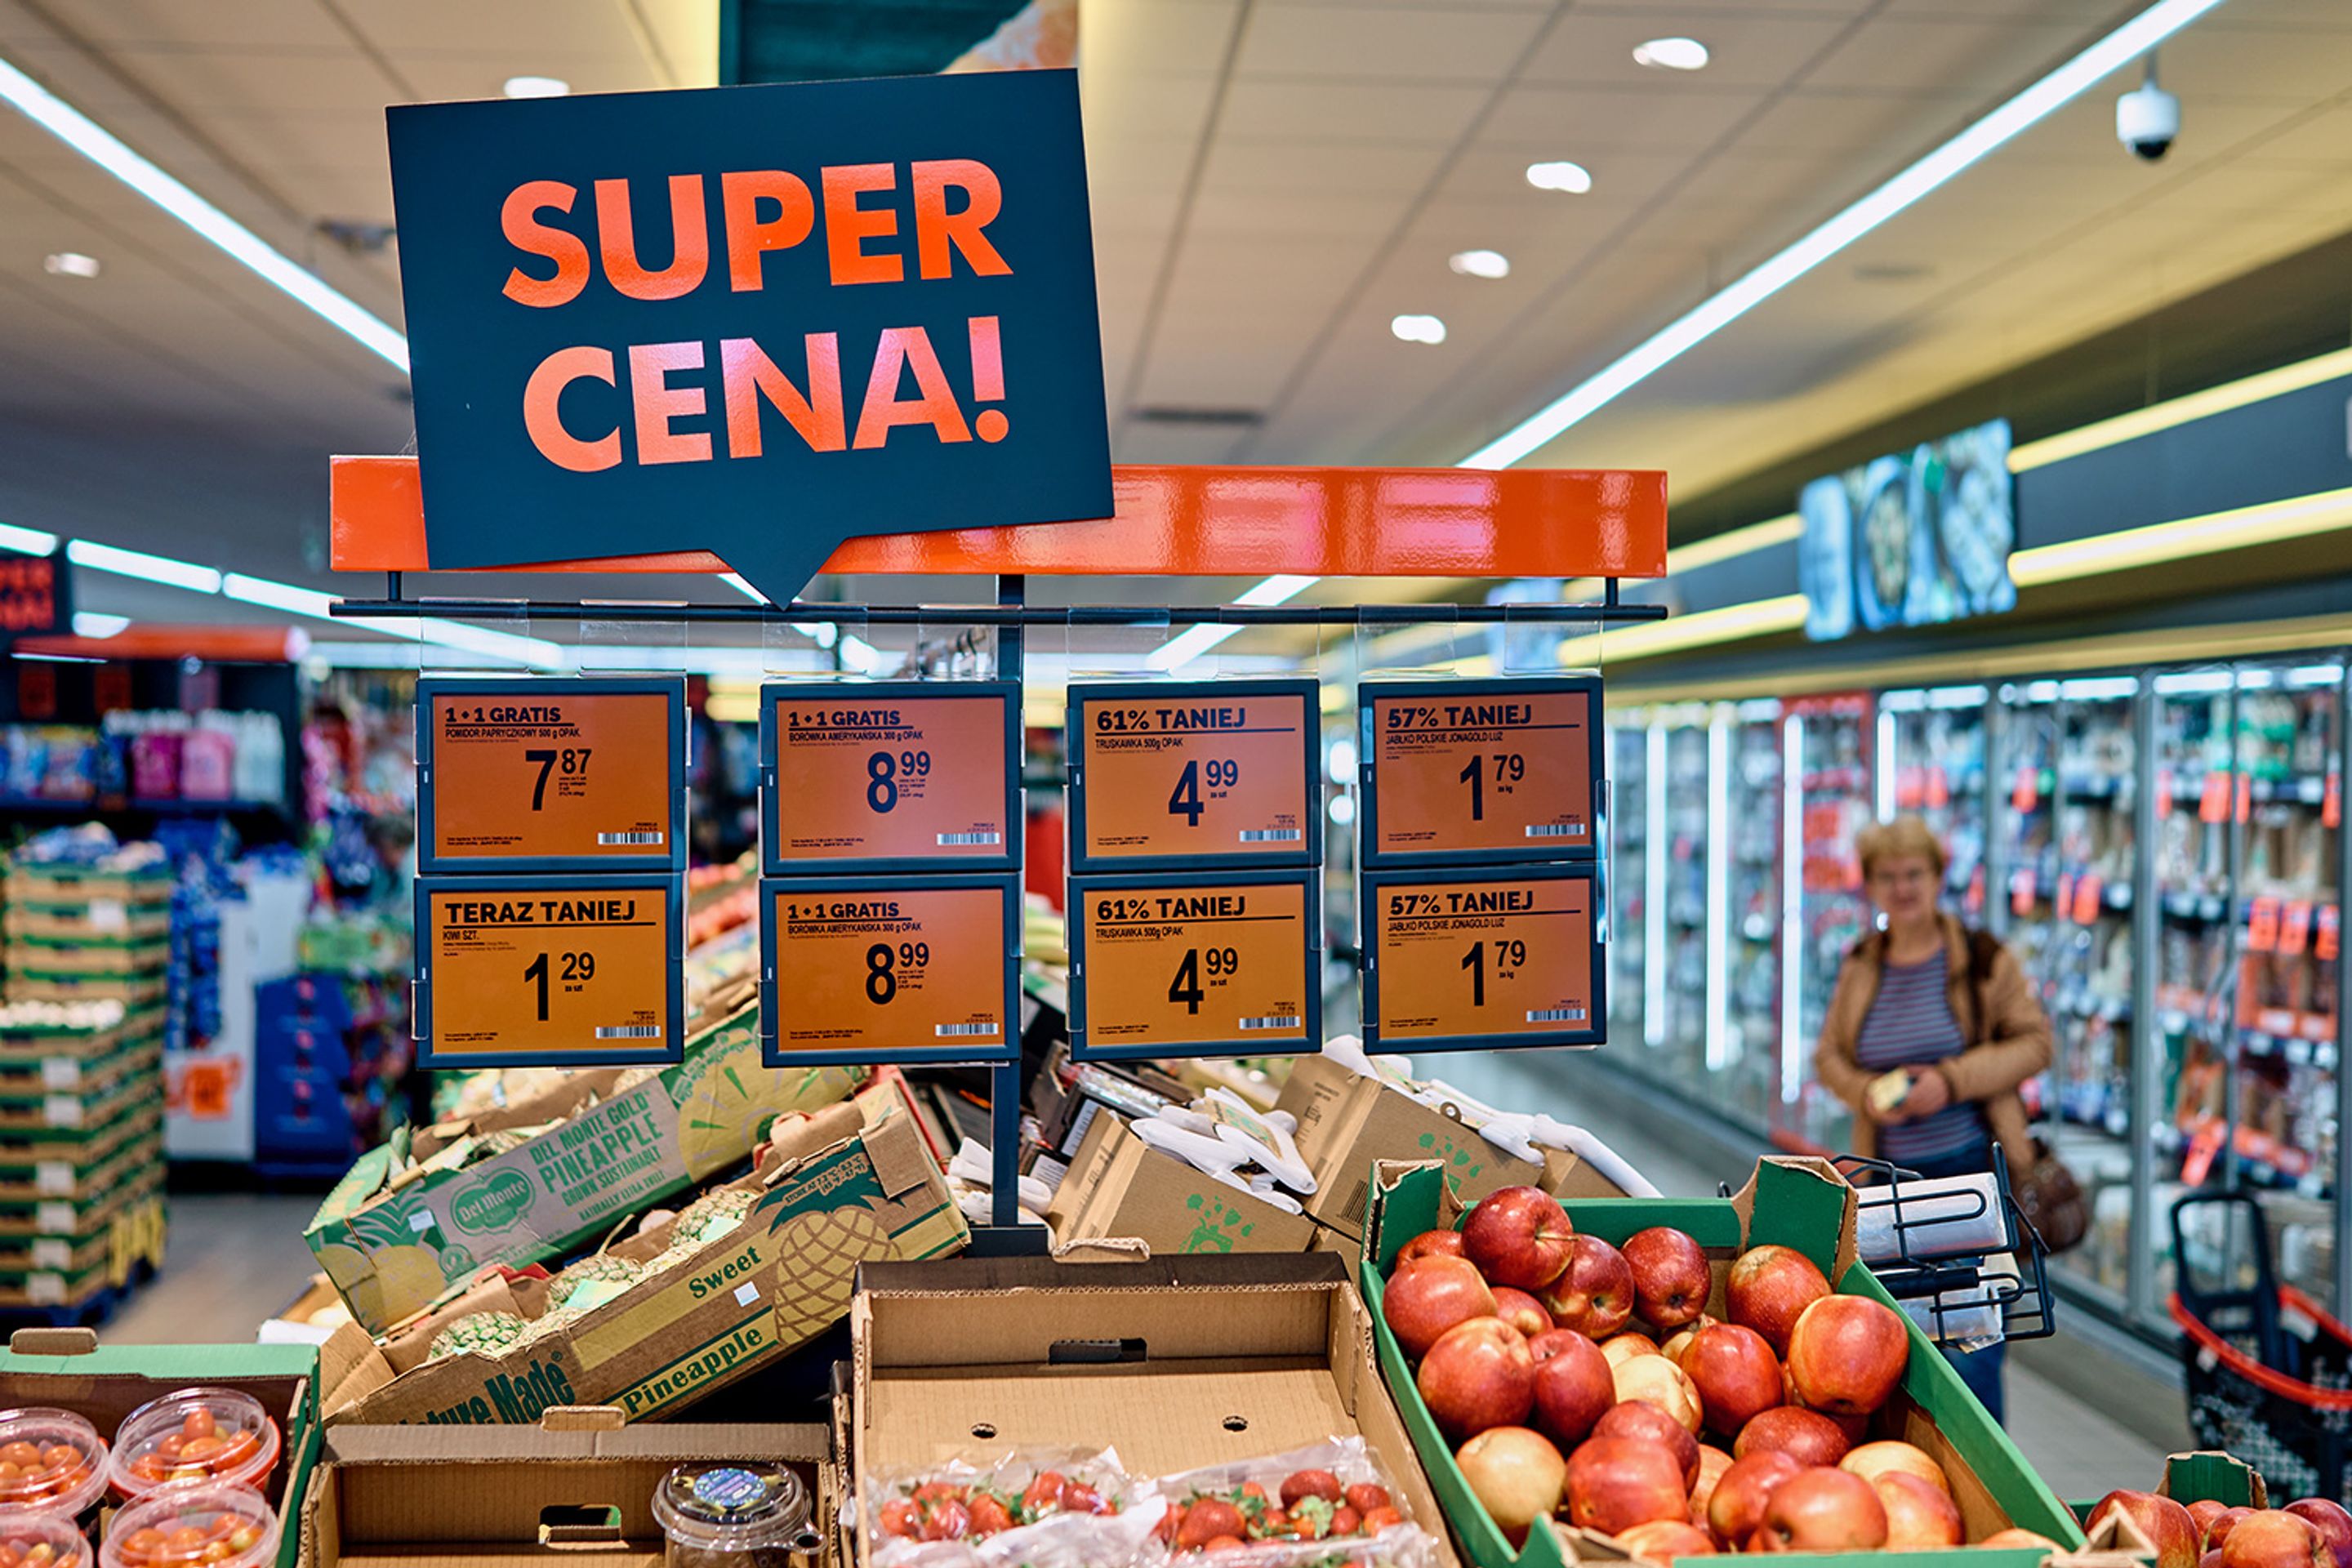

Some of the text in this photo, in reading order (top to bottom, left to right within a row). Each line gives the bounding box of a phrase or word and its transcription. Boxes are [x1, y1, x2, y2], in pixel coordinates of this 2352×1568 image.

[501, 158, 1014, 308] SUPER
[522, 315, 1009, 473] CENA!
[489, 707, 561, 722] GRATIS
[831, 710, 901, 725] GRATIS
[1097, 708, 1245, 731] 61% TANIEJ
[1388, 704, 1531, 728] 57% TANIEJ
[525, 750, 557, 811] 7
[562, 748, 592, 774] 87
[866, 751, 898, 813] 8
[901, 751, 931, 776] 99
[1169, 760, 1238, 827] 4 99
[1459, 754, 1525, 821] 1 79
[444, 900, 635, 924] TERAZ TANIEJ
[831, 902, 899, 918] GRATIS
[1097, 896, 1245, 920] 61% TANIEJ
[1390, 890, 1533, 915] 57% TANIEJ
[524, 951, 595, 1021] 1 29
[866, 943, 896, 1004] 8
[899, 942, 929, 967] 99
[1169, 947, 1238, 1014] 4 99
[1461, 940, 1526, 1006] 1 79
[529, 1142, 561, 1165] DEL
[559, 1112, 608, 1145] MONTE
[538, 1111, 664, 1194] PINEAPPLE
[459, 1201, 483, 1222] Del
[483, 1182, 528, 1210] Monte
[561, 1178, 599, 1207] GROWN
[688, 1246, 762, 1298] Sweet
[622, 1329, 763, 1414] Pineapple
